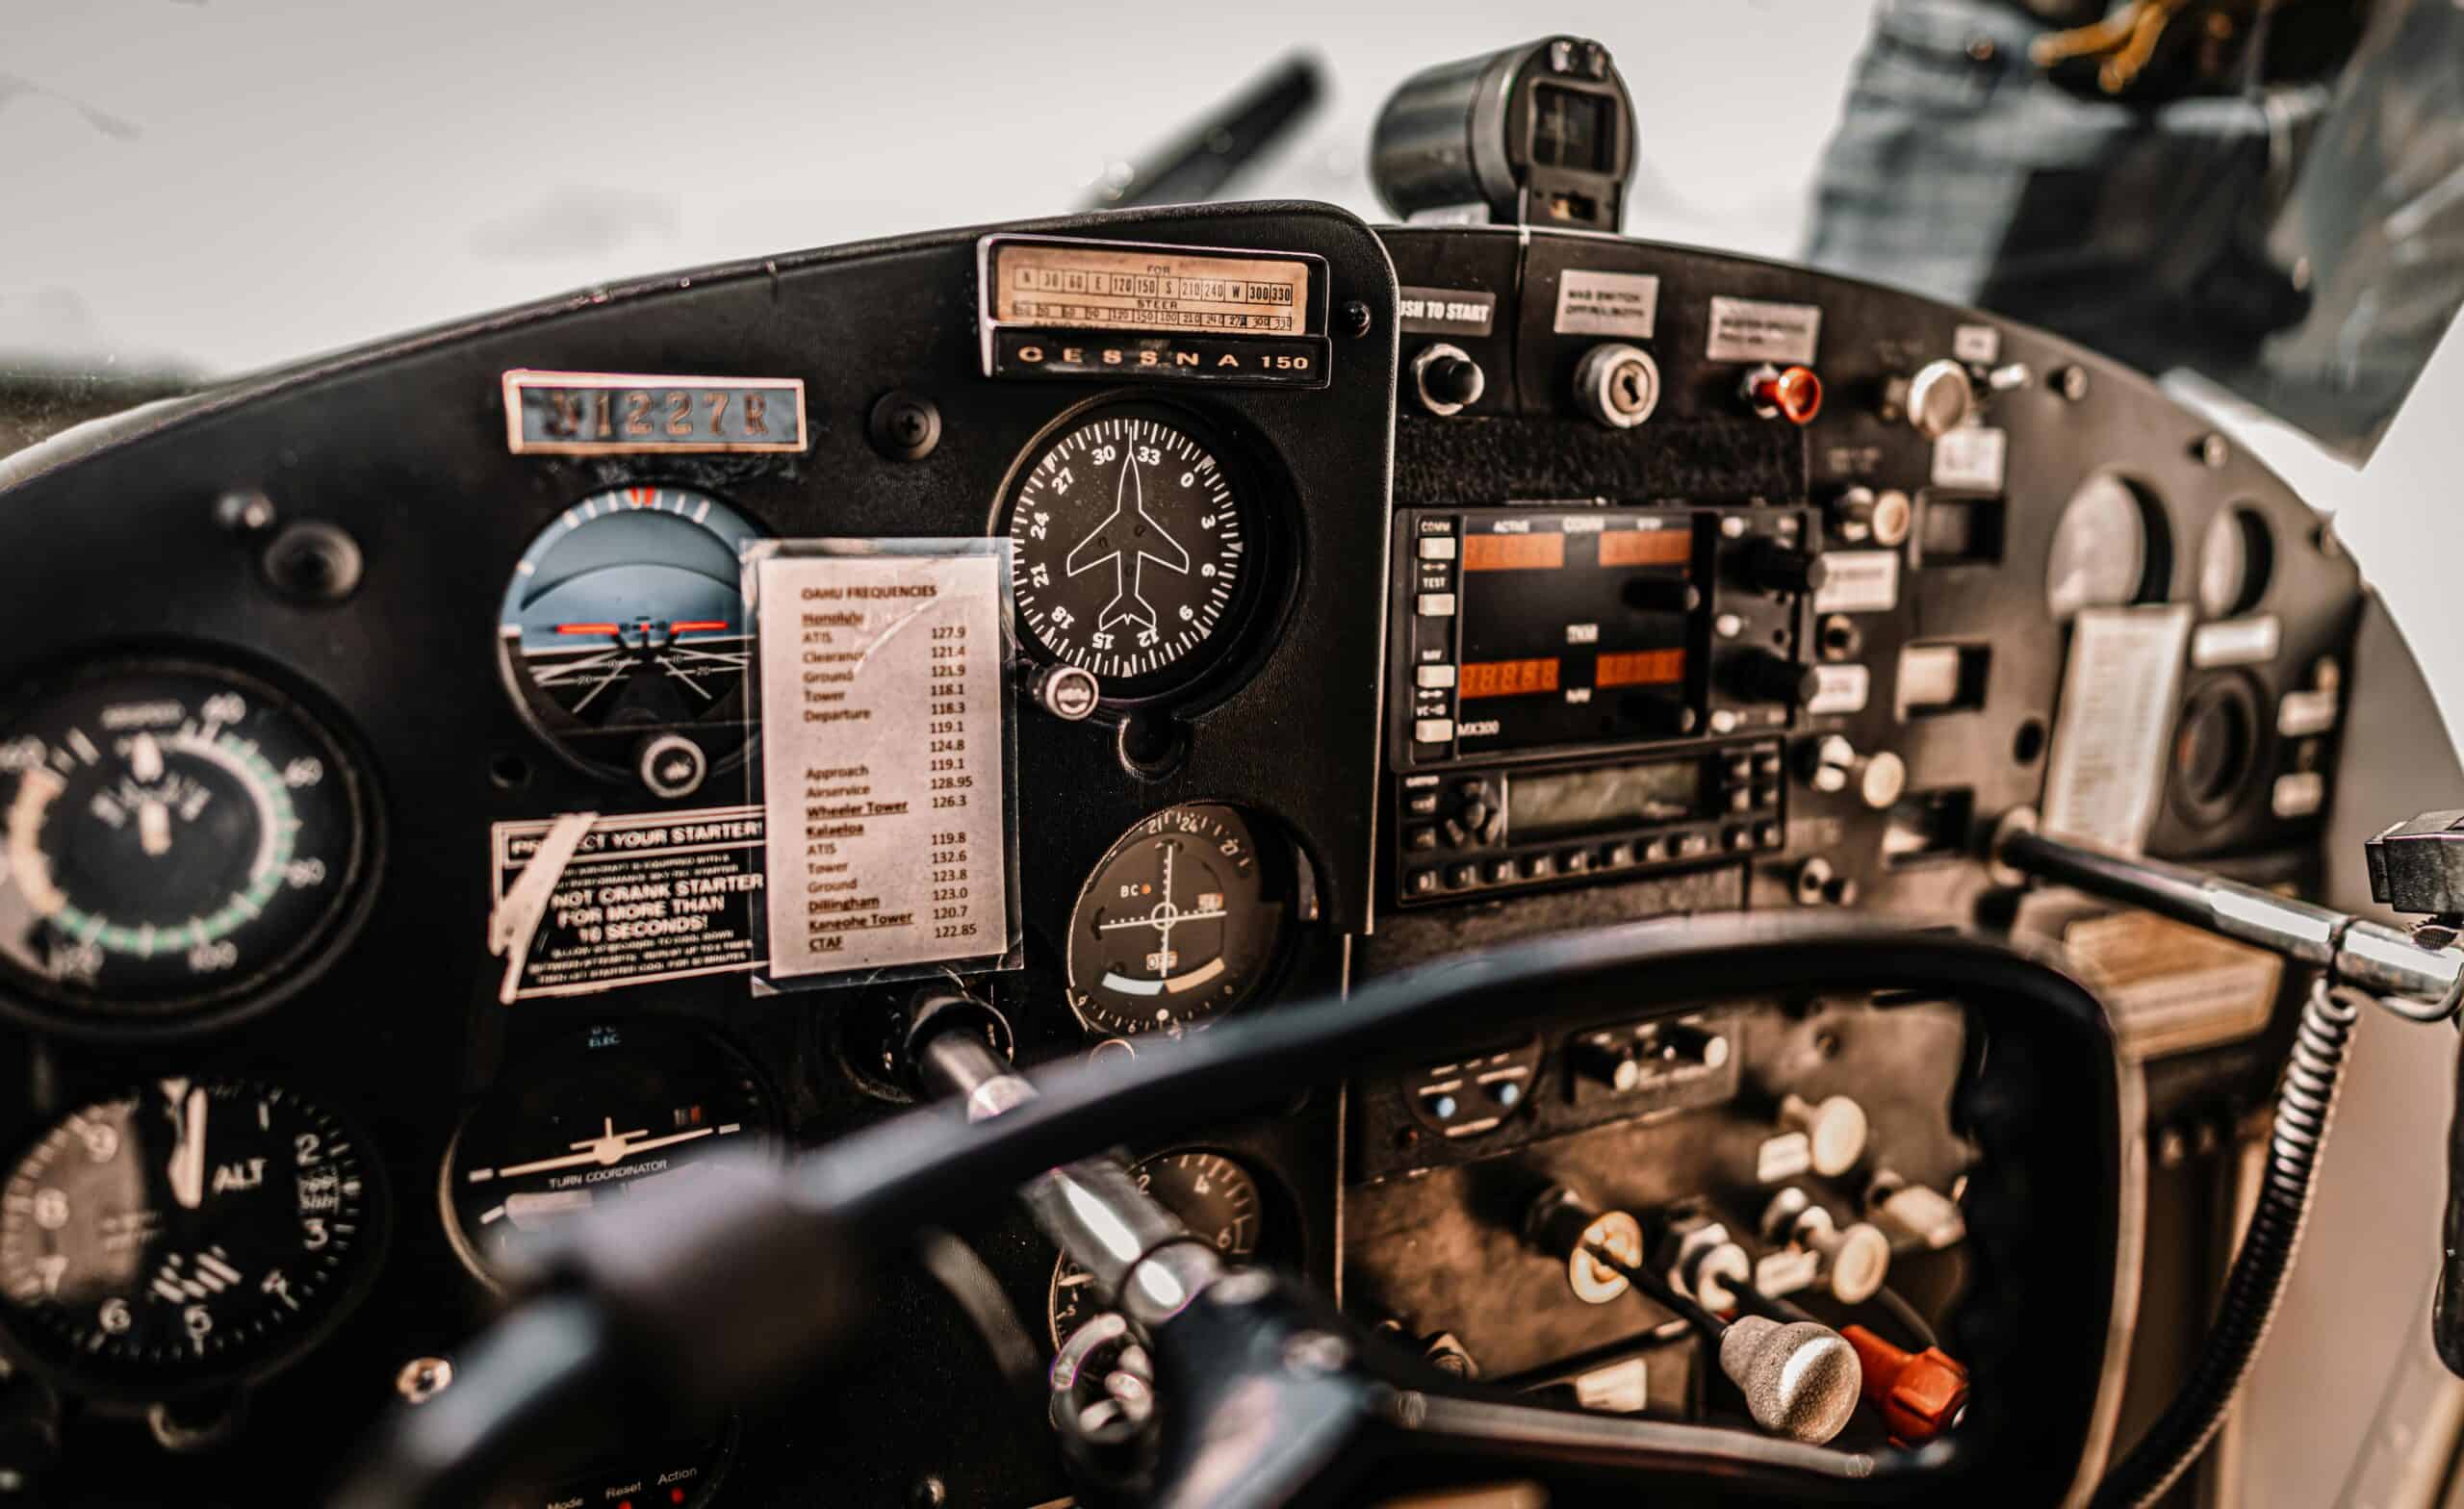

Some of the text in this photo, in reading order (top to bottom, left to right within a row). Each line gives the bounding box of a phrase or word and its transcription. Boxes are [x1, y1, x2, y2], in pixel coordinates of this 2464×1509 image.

[1114, 277, 1132, 293] 120
[1138, 278, 1155, 294] 150
[1166, 280, 1172, 294] S
[1182, 281, 1201, 296] 210
[1204, 284, 1224, 298] 240
[1232, 285, 1241, 299] W
[1249, 286, 1269, 300] 300
[1271, 287, 1291, 302] 330
[1137, 299, 1178, 310] STEER
[1399, 300, 1489, 323] USH TO START
[1018, 345, 1309, 371] CESSNA 150
[1091, 446, 1161, 466] 30 33
[1051, 471, 1074, 495] 27
[1180, 472, 1194, 488] 0
[1030, 512, 1050, 540] 24
[1201, 515, 1216, 529] 3
[1030, 562, 1050, 588] 21
[1201, 563, 1216, 577] 6
[846, 584, 937, 600] FREQUENCIES
[1423, 577, 1446, 589] TEST
[1051, 605, 1075, 629] 18
[931, 627, 966, 640] 127.9
[1091, 631, 1115, 650] 15
[1137, 628, 1160, 648] 12
[803, 647, 965, 664] Clearanc 121.4
[931, 665, 965, 678] 121.9
[804, 684, 964, 702] Tower 118.1
[804, 703, 965, 724] Departure 118.3
[930, 721, 964, 733] 119.1
[930, 740, 965, 753] 124.8
[807, 759, 965, 781] Approach 119.1
[807, 777, 973, 799] Airservice 128.95
[807, 796, 967, 818] Wheeler Tower 126.3
[1180, 816, 1198, 832] 24
[510, 821, 763, 856] PRCT YOUR STARTER!
[807, 832, 966, 856] ATIS 119.8
[808, 851, 967, 874] Tower 132.6
[552, 891, 593, 910] NOT
[598, 883, 671, 905] CRANK
[675, 873, 764, 896] STARTER
[808, 869, 967, 893] Ground 123.8
[1120, 884, 1139, 898] BC
[808, 888, 968, 914] Dillingham 123.0
[557, 895, 726, 930] FOR MORE THAN
[808, 907, 968, 933] Kaneohe Tower 120.7
[604, 914, 708, 941] SECONDS!
[808, 924, 977, 951] CTAF 122.85
[294, 1133, 321, 1165] 2
[212, 1157, 268, 1194] ALT
[549, 1159, 668, 1189] TURN COORDINATOR
[1137, 1174, 1151, 1196] 2
[1194, 1174, 1210, 1194] 4
[302, 1217, 329, 1250] 3
[1217, 1228, 1232, 1248] 6
[98, 1297, 132, 1336] 6
[657, 1467, 697, 1486] Action
[605, 1481, 642, 1499] Reset
[547, 1496, 584, 1509] Mode
